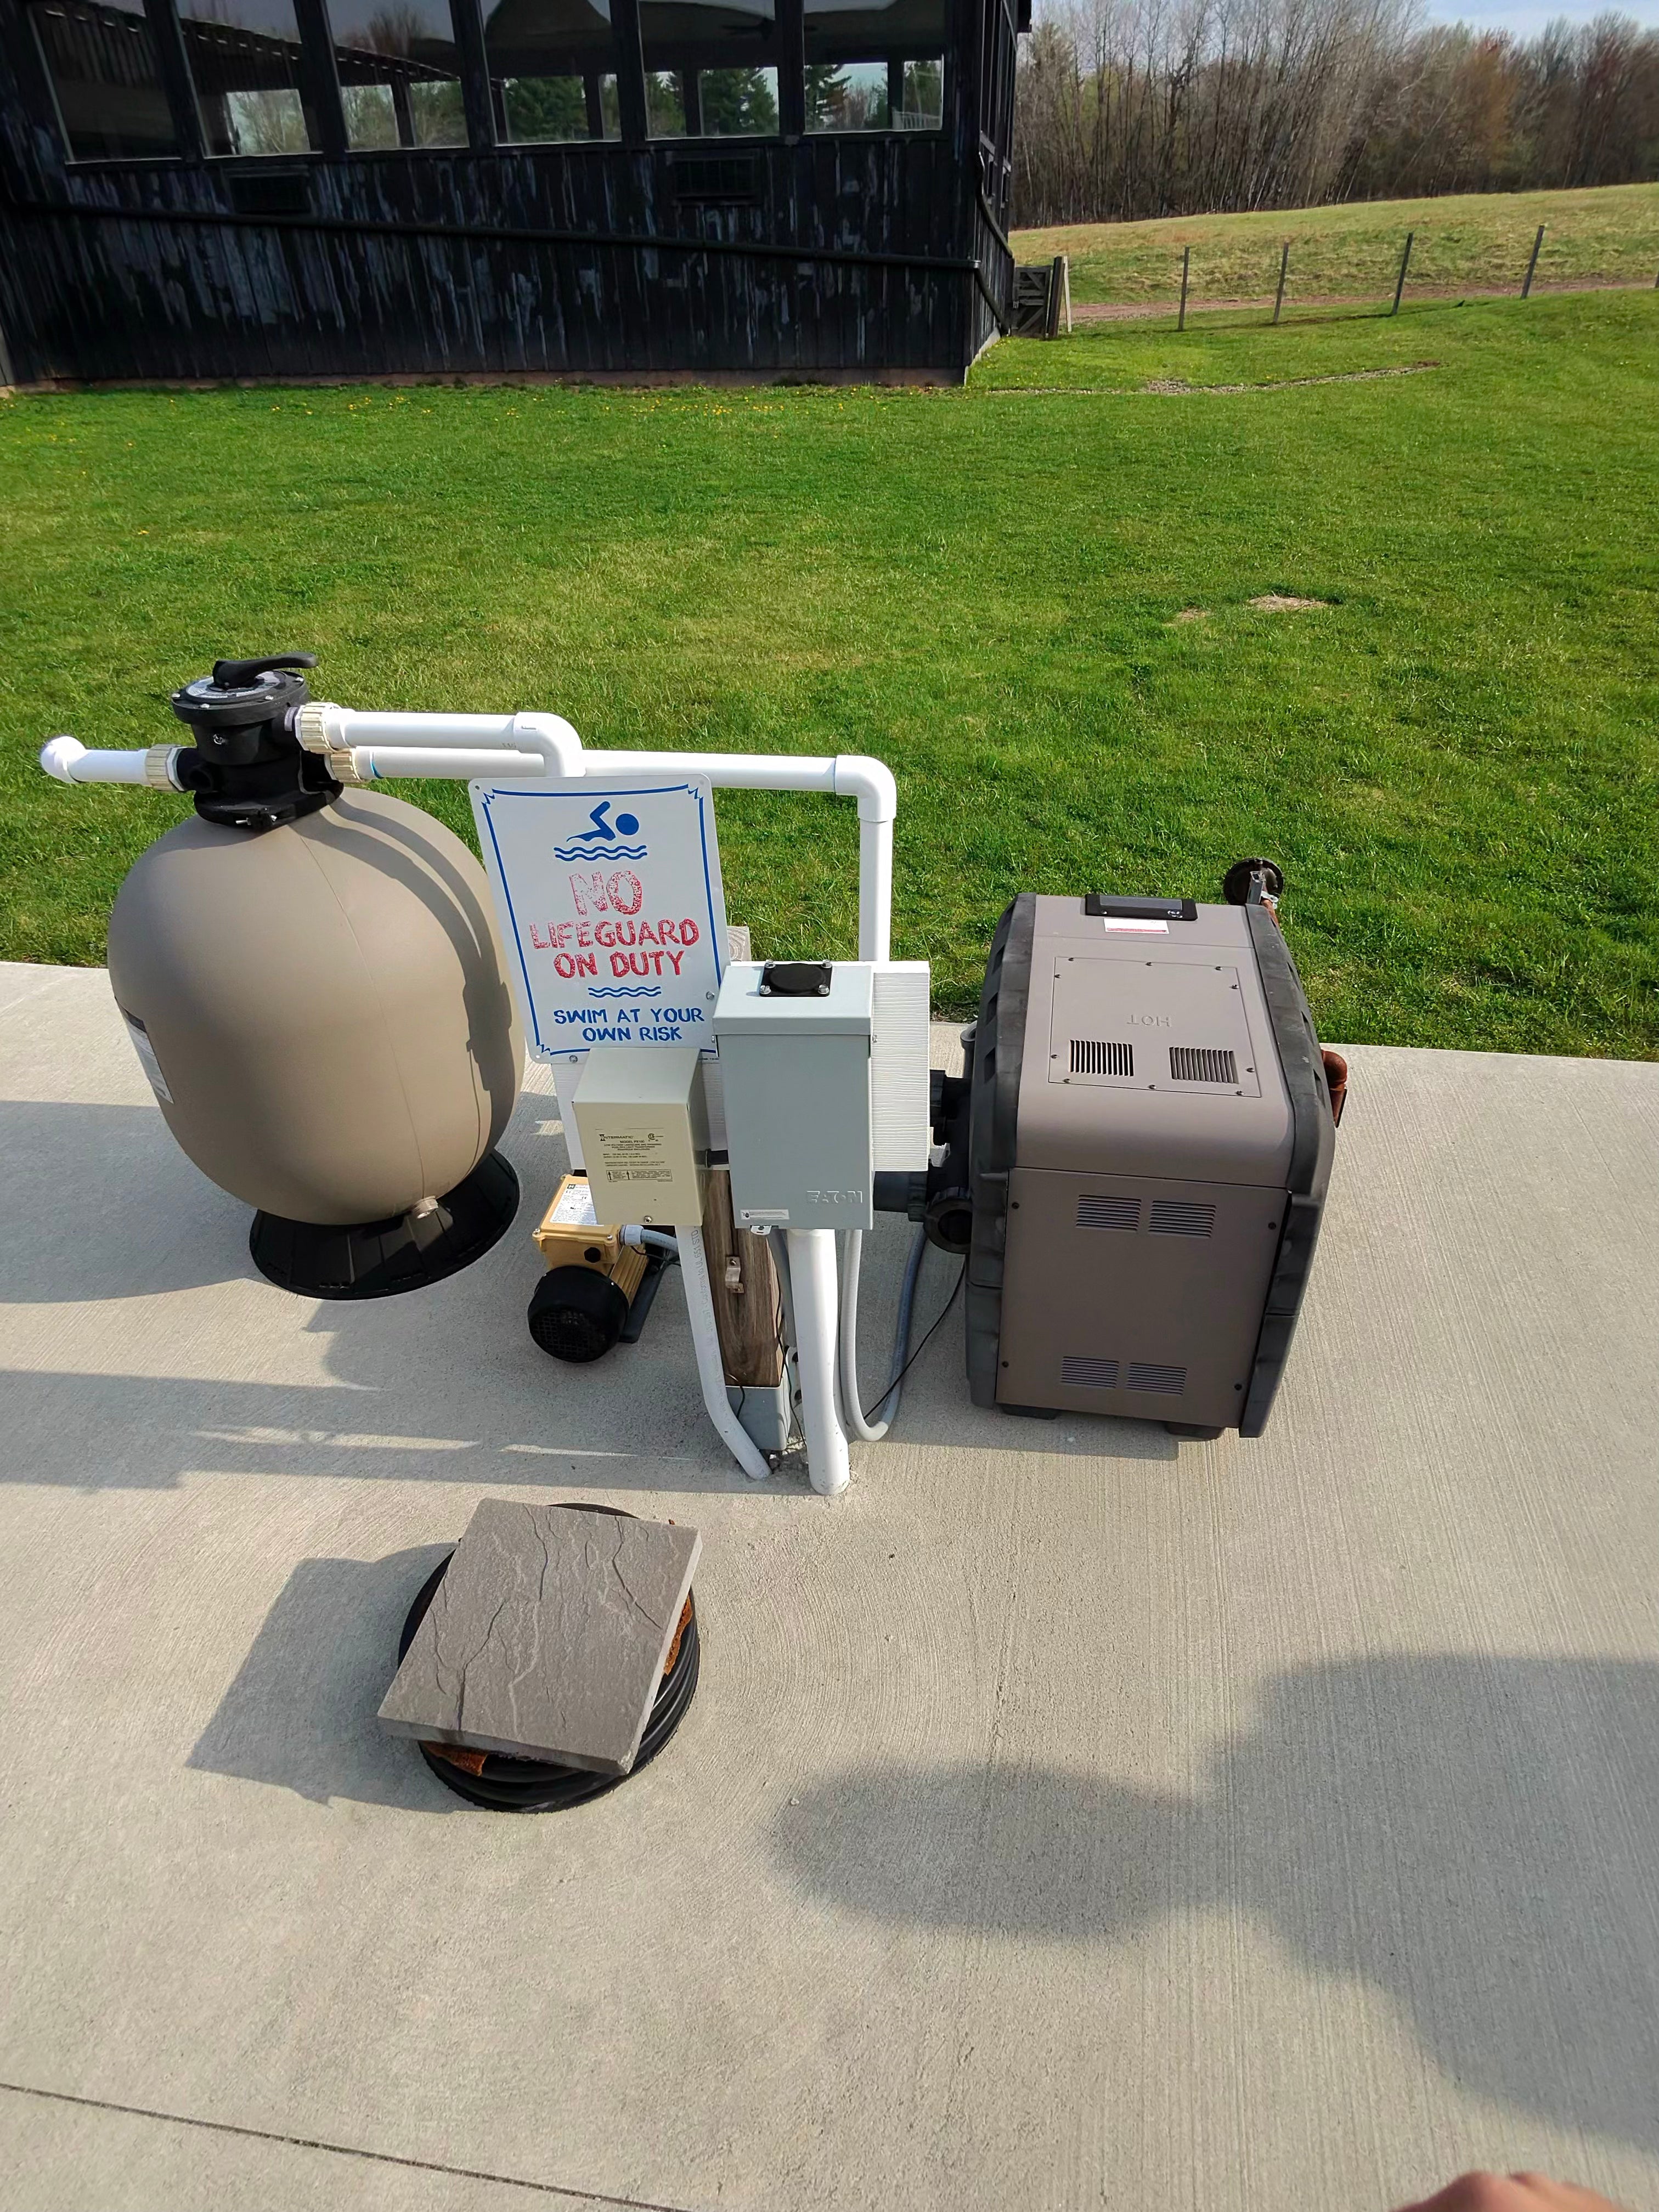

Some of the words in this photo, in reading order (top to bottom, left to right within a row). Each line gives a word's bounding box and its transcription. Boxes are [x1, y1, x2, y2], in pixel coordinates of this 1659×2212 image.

[569, 870, 643, 916] NO
[529, 918, 700, 950] LIFEGUARD
[553, 952, 599, 979] ON
[610, 950, 685, 978] DUTY
[554, 1009, 608, 1025] SWIM
[617, 1009, 641, 1024] AT
[651, 1008, 705, 1024] YOUR
[1126, 1014, 1171, 1027] HOT
[583, 1027, 631, 1042] OWN
[639, 1026, 682, 1042] RISK
[806, 1190, 862, 1204] EATON
